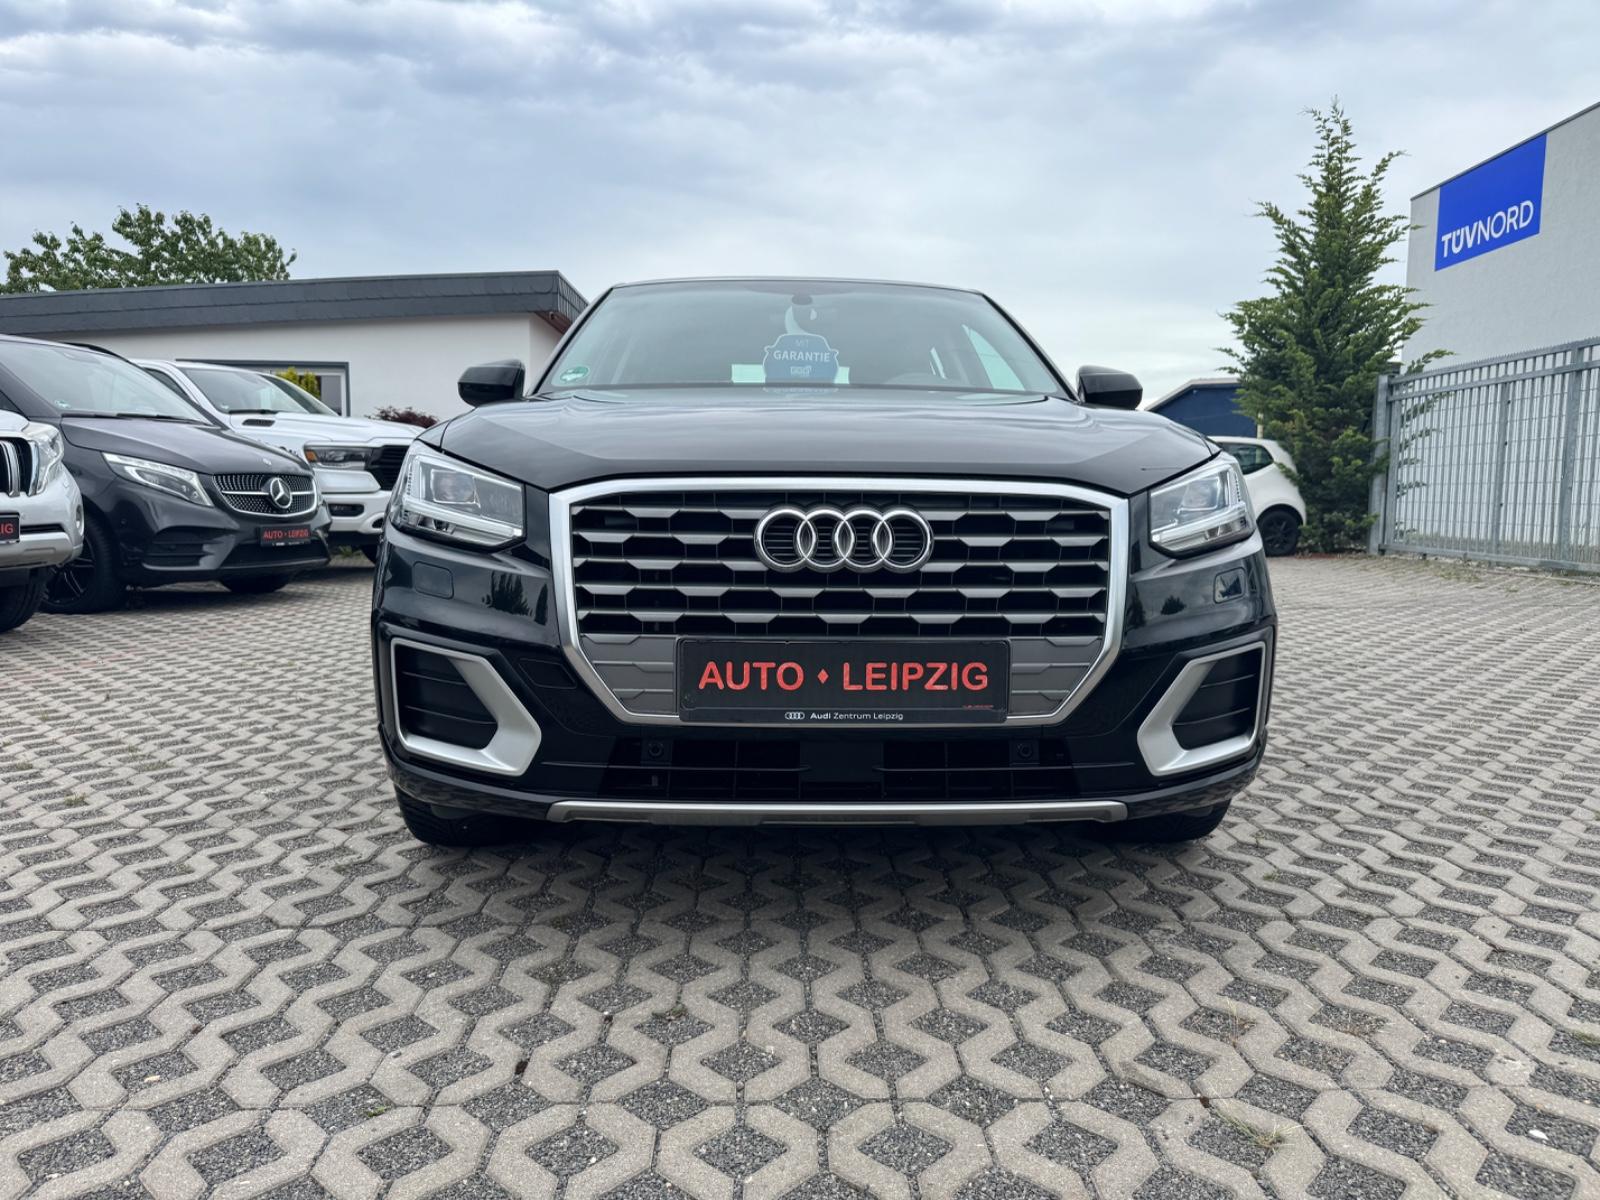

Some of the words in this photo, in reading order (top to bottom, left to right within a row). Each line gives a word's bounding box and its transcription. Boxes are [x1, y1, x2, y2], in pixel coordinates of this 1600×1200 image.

[773, 350, 830, 362] GARANTIE
[263, 530, 283, 540] AUTO
[698, 661, 805, 691] AUTO
[842, 661, 989, 691] LEIPZIG
[810, 712, 831, 720] Audi
[833, 712, 872, 720] Zentrum
[873, 712, 904, 721] Leipzig
